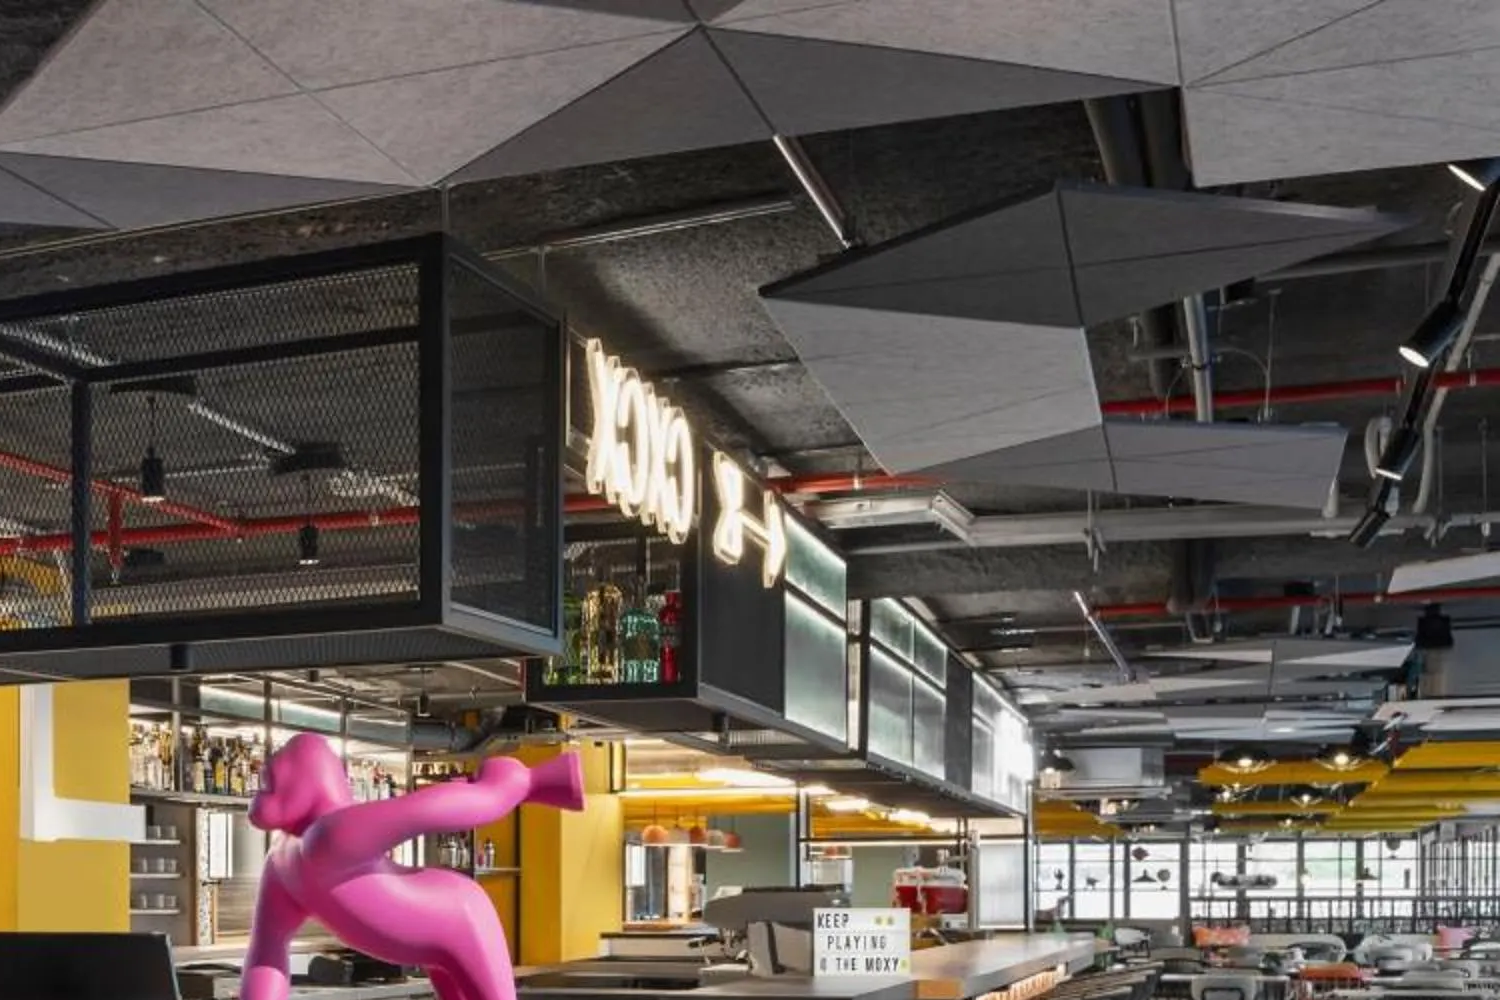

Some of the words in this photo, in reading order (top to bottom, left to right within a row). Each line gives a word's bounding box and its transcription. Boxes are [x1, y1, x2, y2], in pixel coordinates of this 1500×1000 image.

[817, 913, 849, 929] KEEP
[827, 935, 887, 950] PLAYING
[836, 957, 857, 971] THE
[865, 957, 899, 972] MOXY
